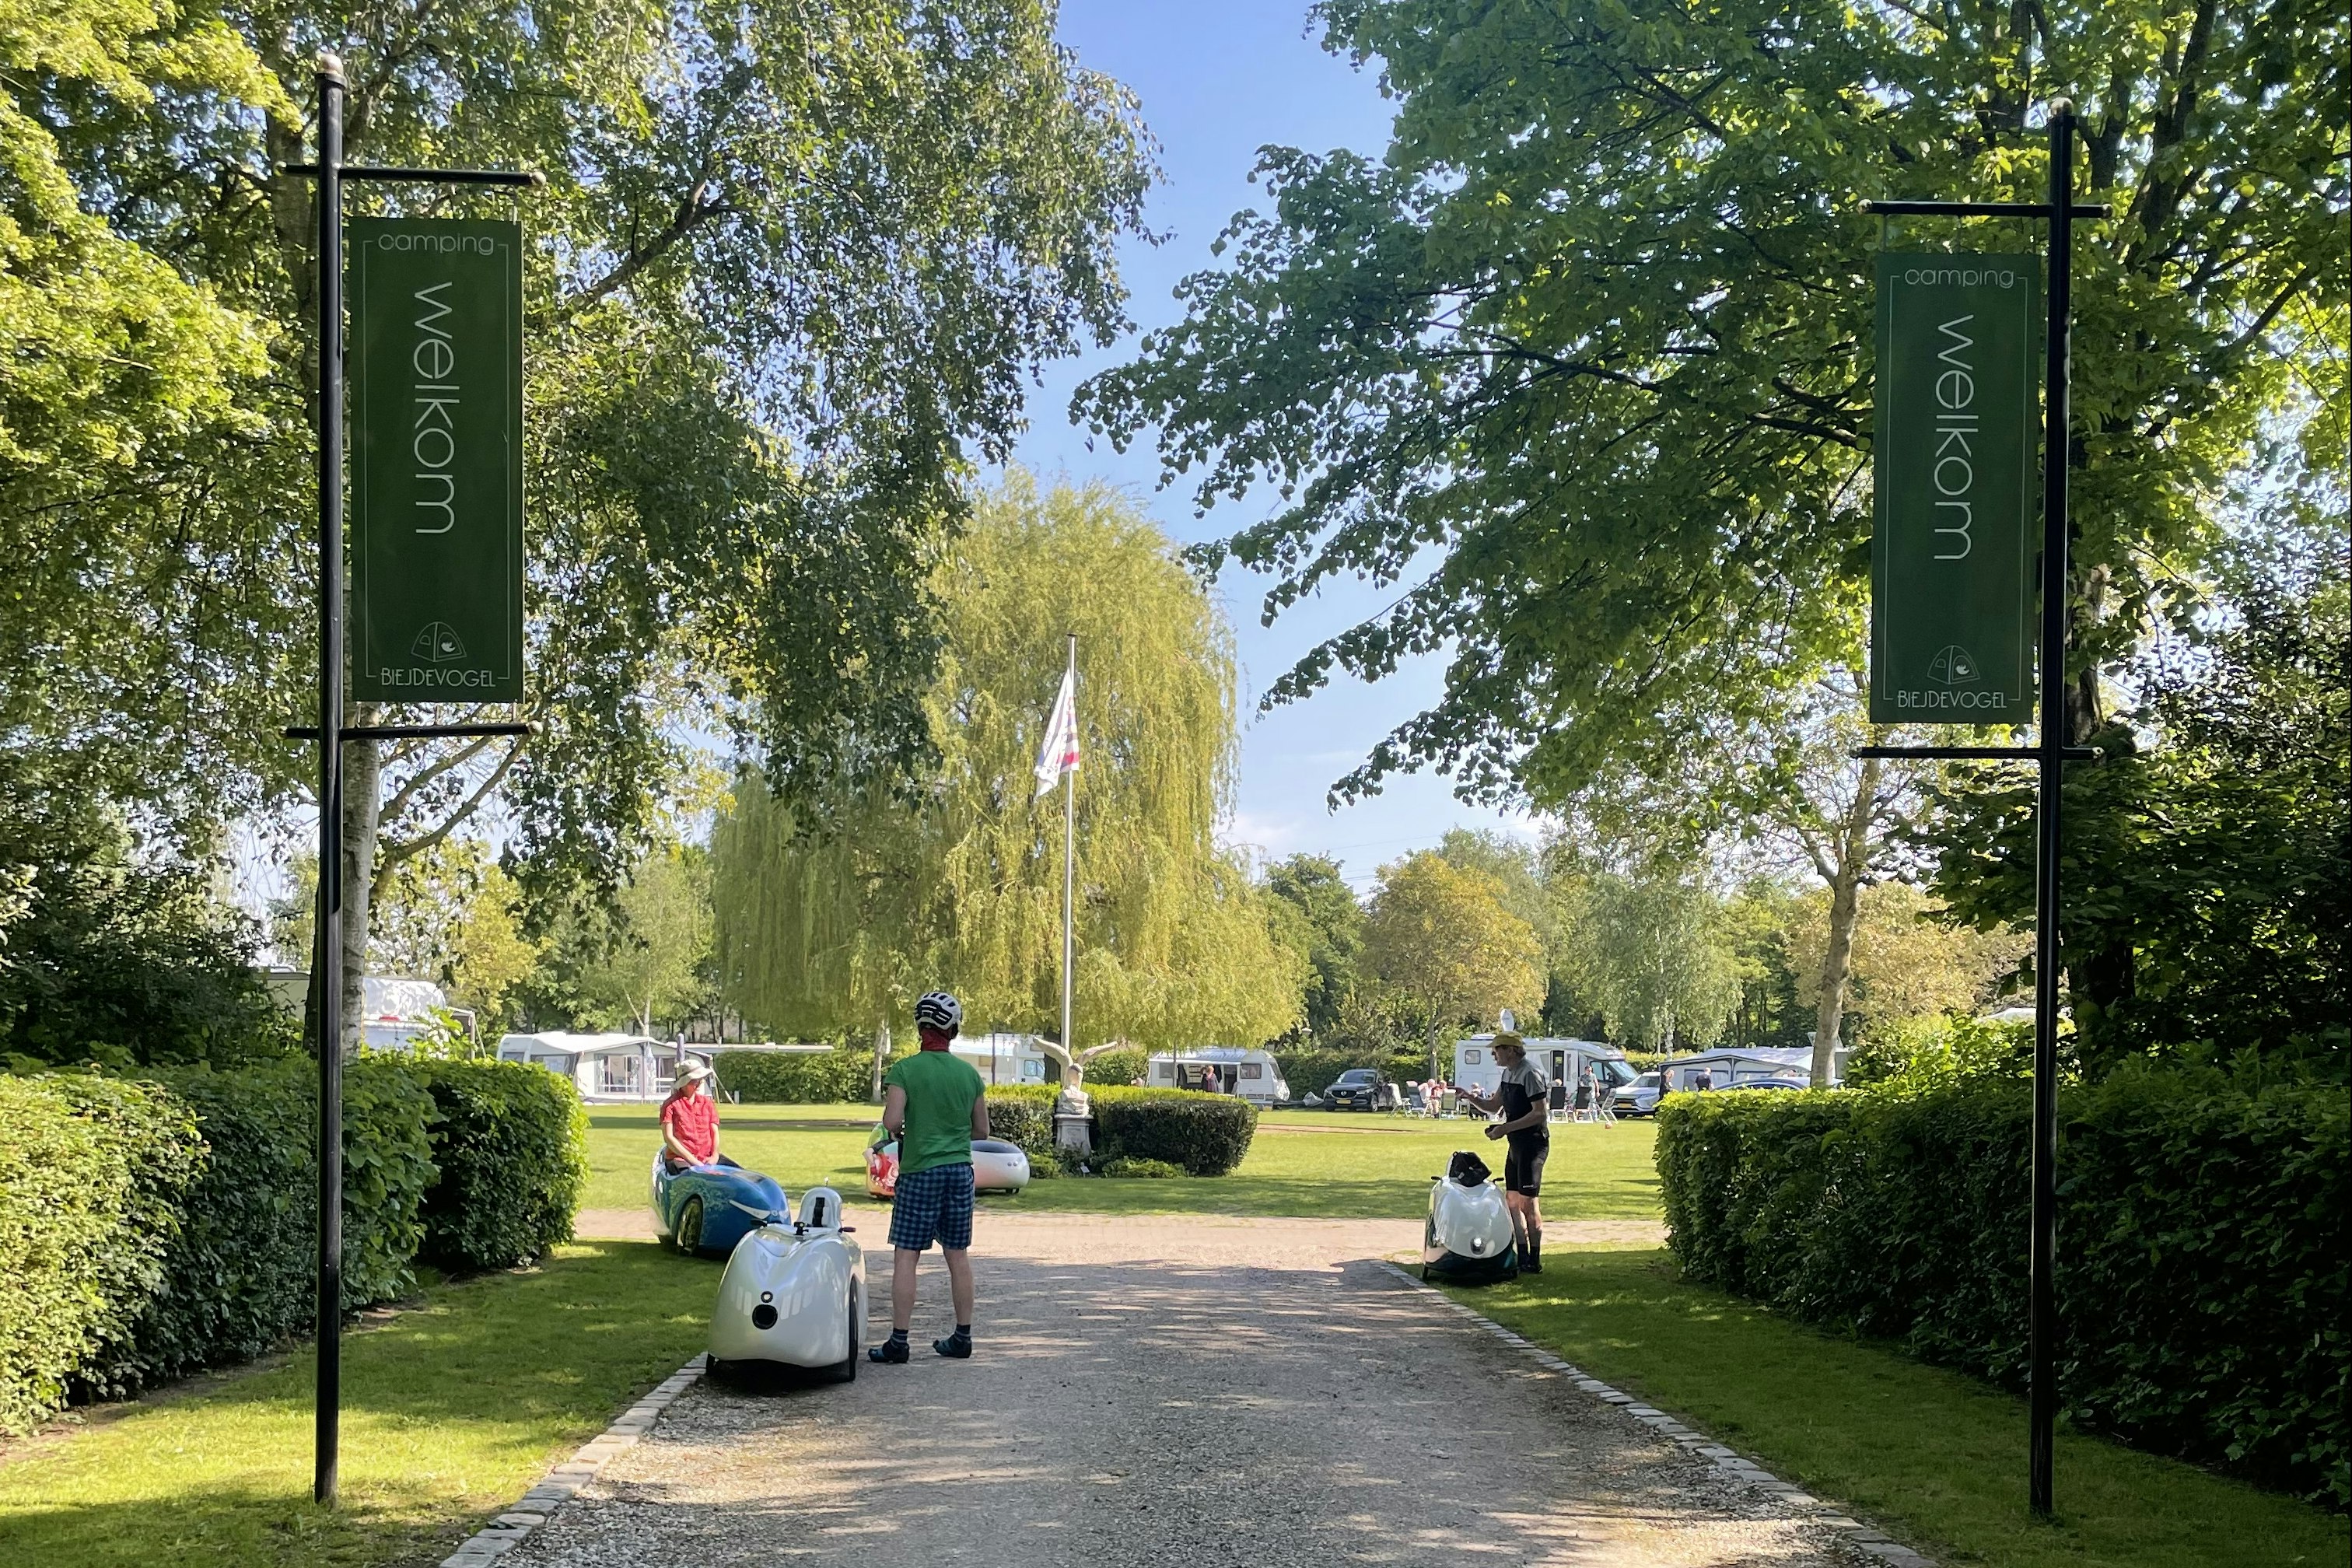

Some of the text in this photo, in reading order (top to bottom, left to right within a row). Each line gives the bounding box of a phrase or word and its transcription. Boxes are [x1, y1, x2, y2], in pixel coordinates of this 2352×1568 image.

[378, 233, 494, 256] camping
[1905, 268, 2014, 289] camping
[413, 282, 460, 534] welkom
[1934, 314, 1979, 560] welkom
[380, 667, 496, 687] BIEJDEVOGEL
[1898, 690, 2007, 709] BIEJDEVOGEL
